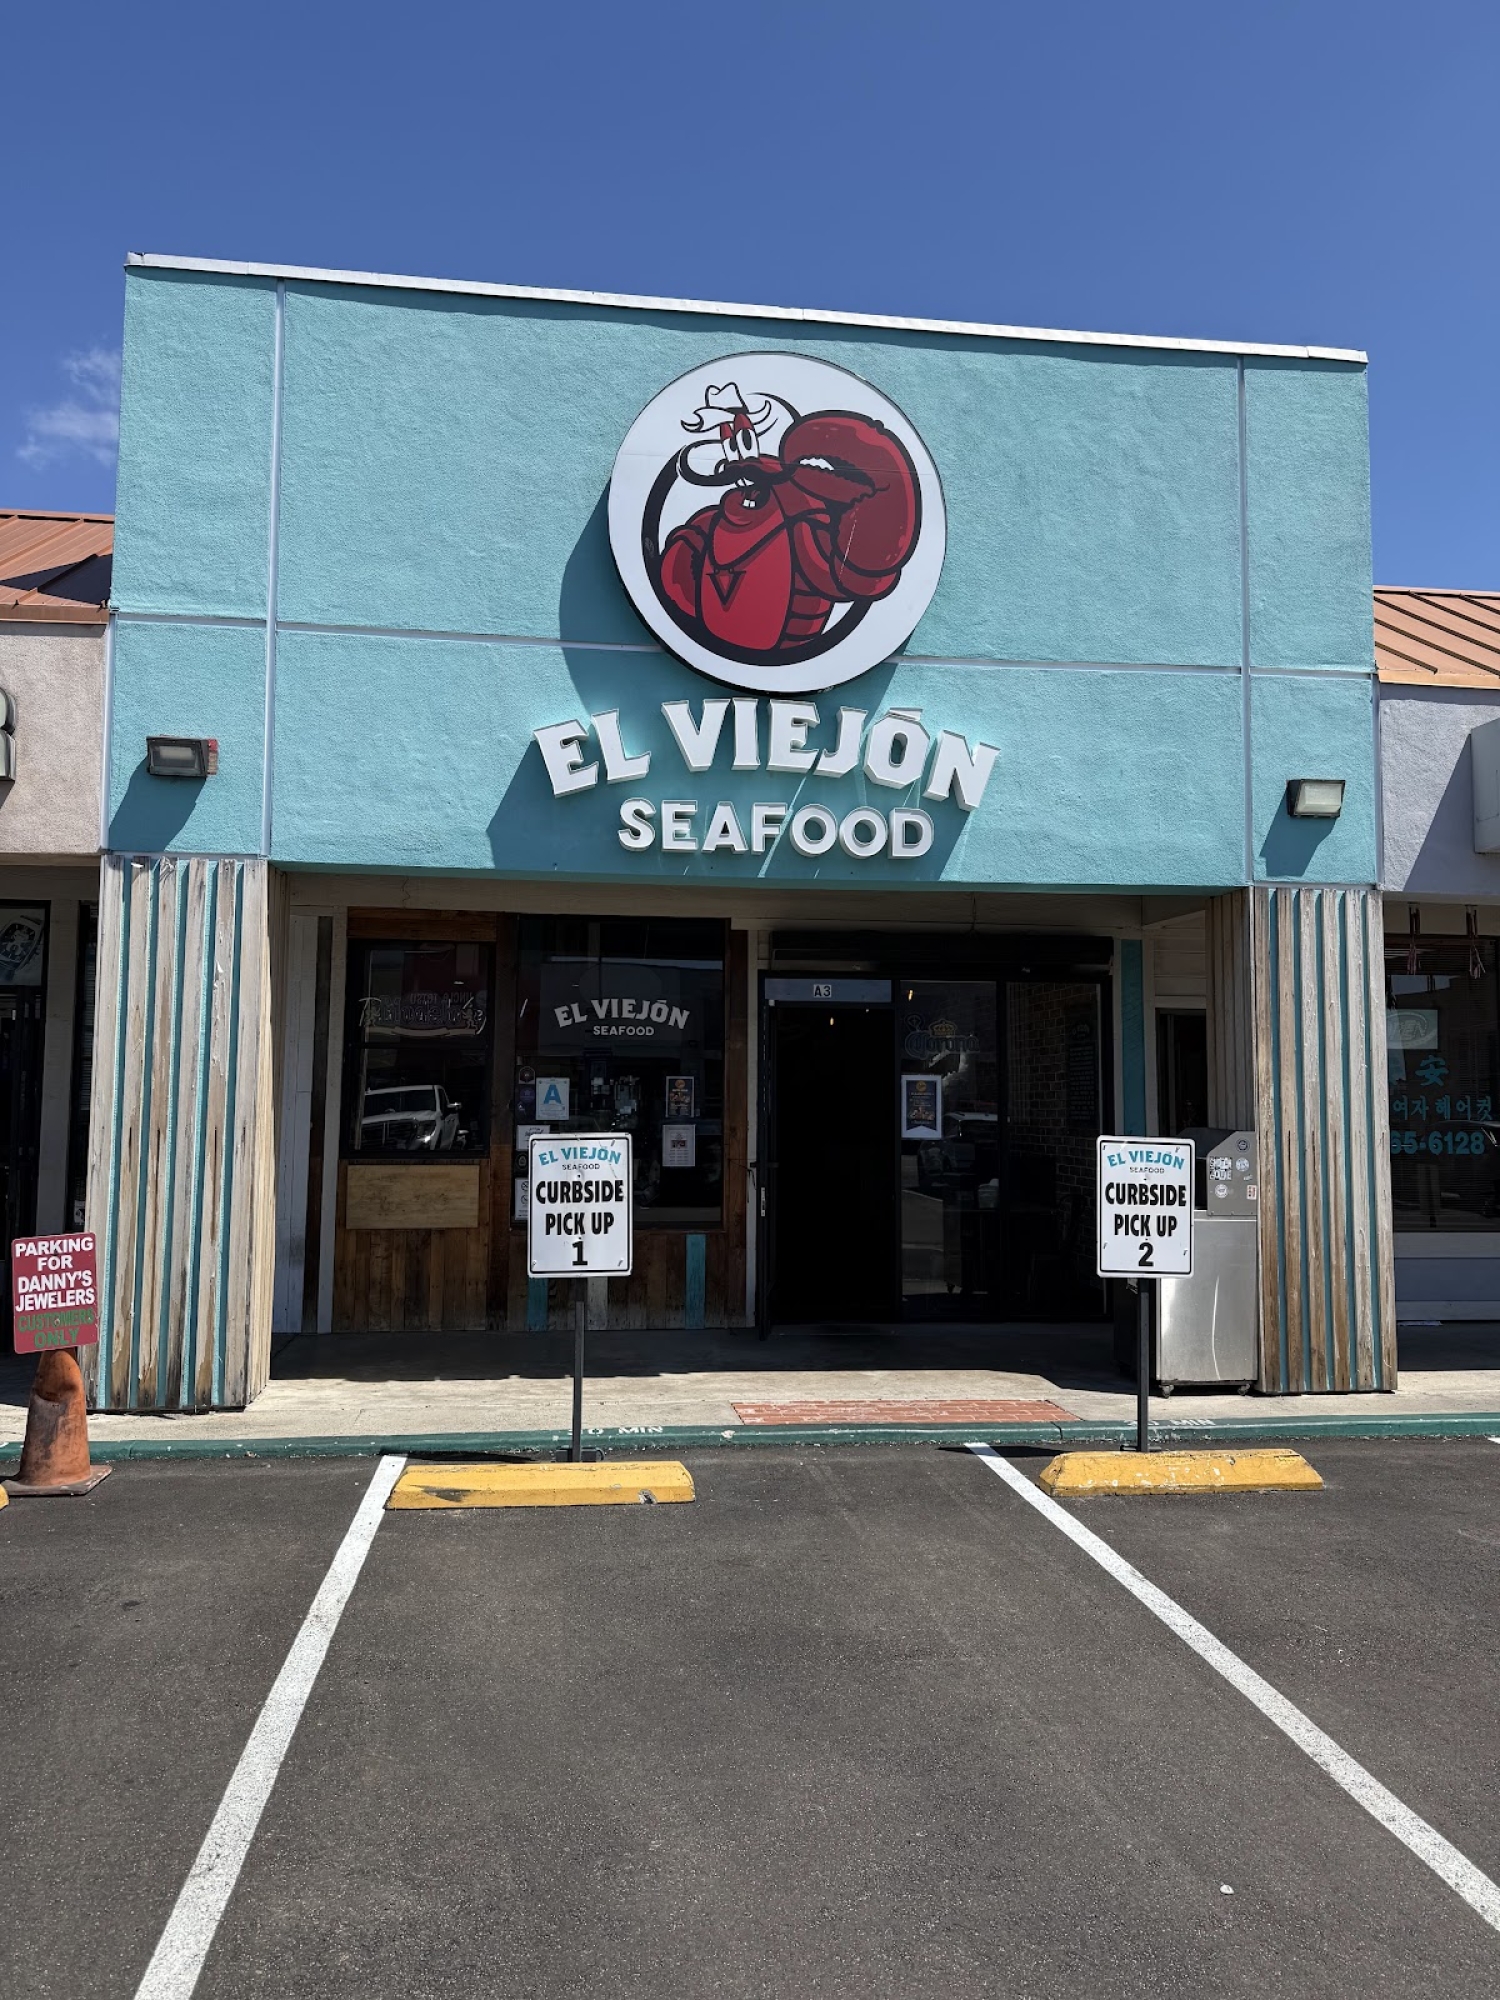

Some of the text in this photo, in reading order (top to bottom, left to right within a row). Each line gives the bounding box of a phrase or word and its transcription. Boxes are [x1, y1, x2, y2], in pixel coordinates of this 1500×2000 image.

[532, 708, 651, 798] EL
[618, 797, 935, 859] SEAFOOD
[814, 985, 831, 997] A3
[554, 1002, 588, 1028] EL
[593, 1025, 655, 1036] SEAFOOD
[543, 1084, 562, 1104] A
[538, 1150, 559, 1166] EL
[562, 1163, 600, 1171] SEAFOOD
[1107, 1153, 1126, 1167] EL
[1129, 1166, 1165, 1174] SEAFOOD
[536, 1180, 624, 1204] CURBSIDE
[1105, 1182, 1187, 1206] CURBSIDE
[545, 1212, 585, 1235] PICK
[591, 1212, 614, 1235] UP
[1114, 1214, 1178, 1237] PICK UP
[15, 1237, 93, 1257] PARKING
[572, 1241, 588, 1266] 1
[1138, 1242, 1154, 1267] 2
[37, 1255, 73, 1272] FOR
[18, 1270, 92, 1294] DANNY'S
[15, 1288, 95, 1312] JEWELERS
[18, 1308, 94, 1332] CUSTOMERS
[34, 1328, 79, 1349] ONLY
[618, 1425, 663, 1434] MIN
